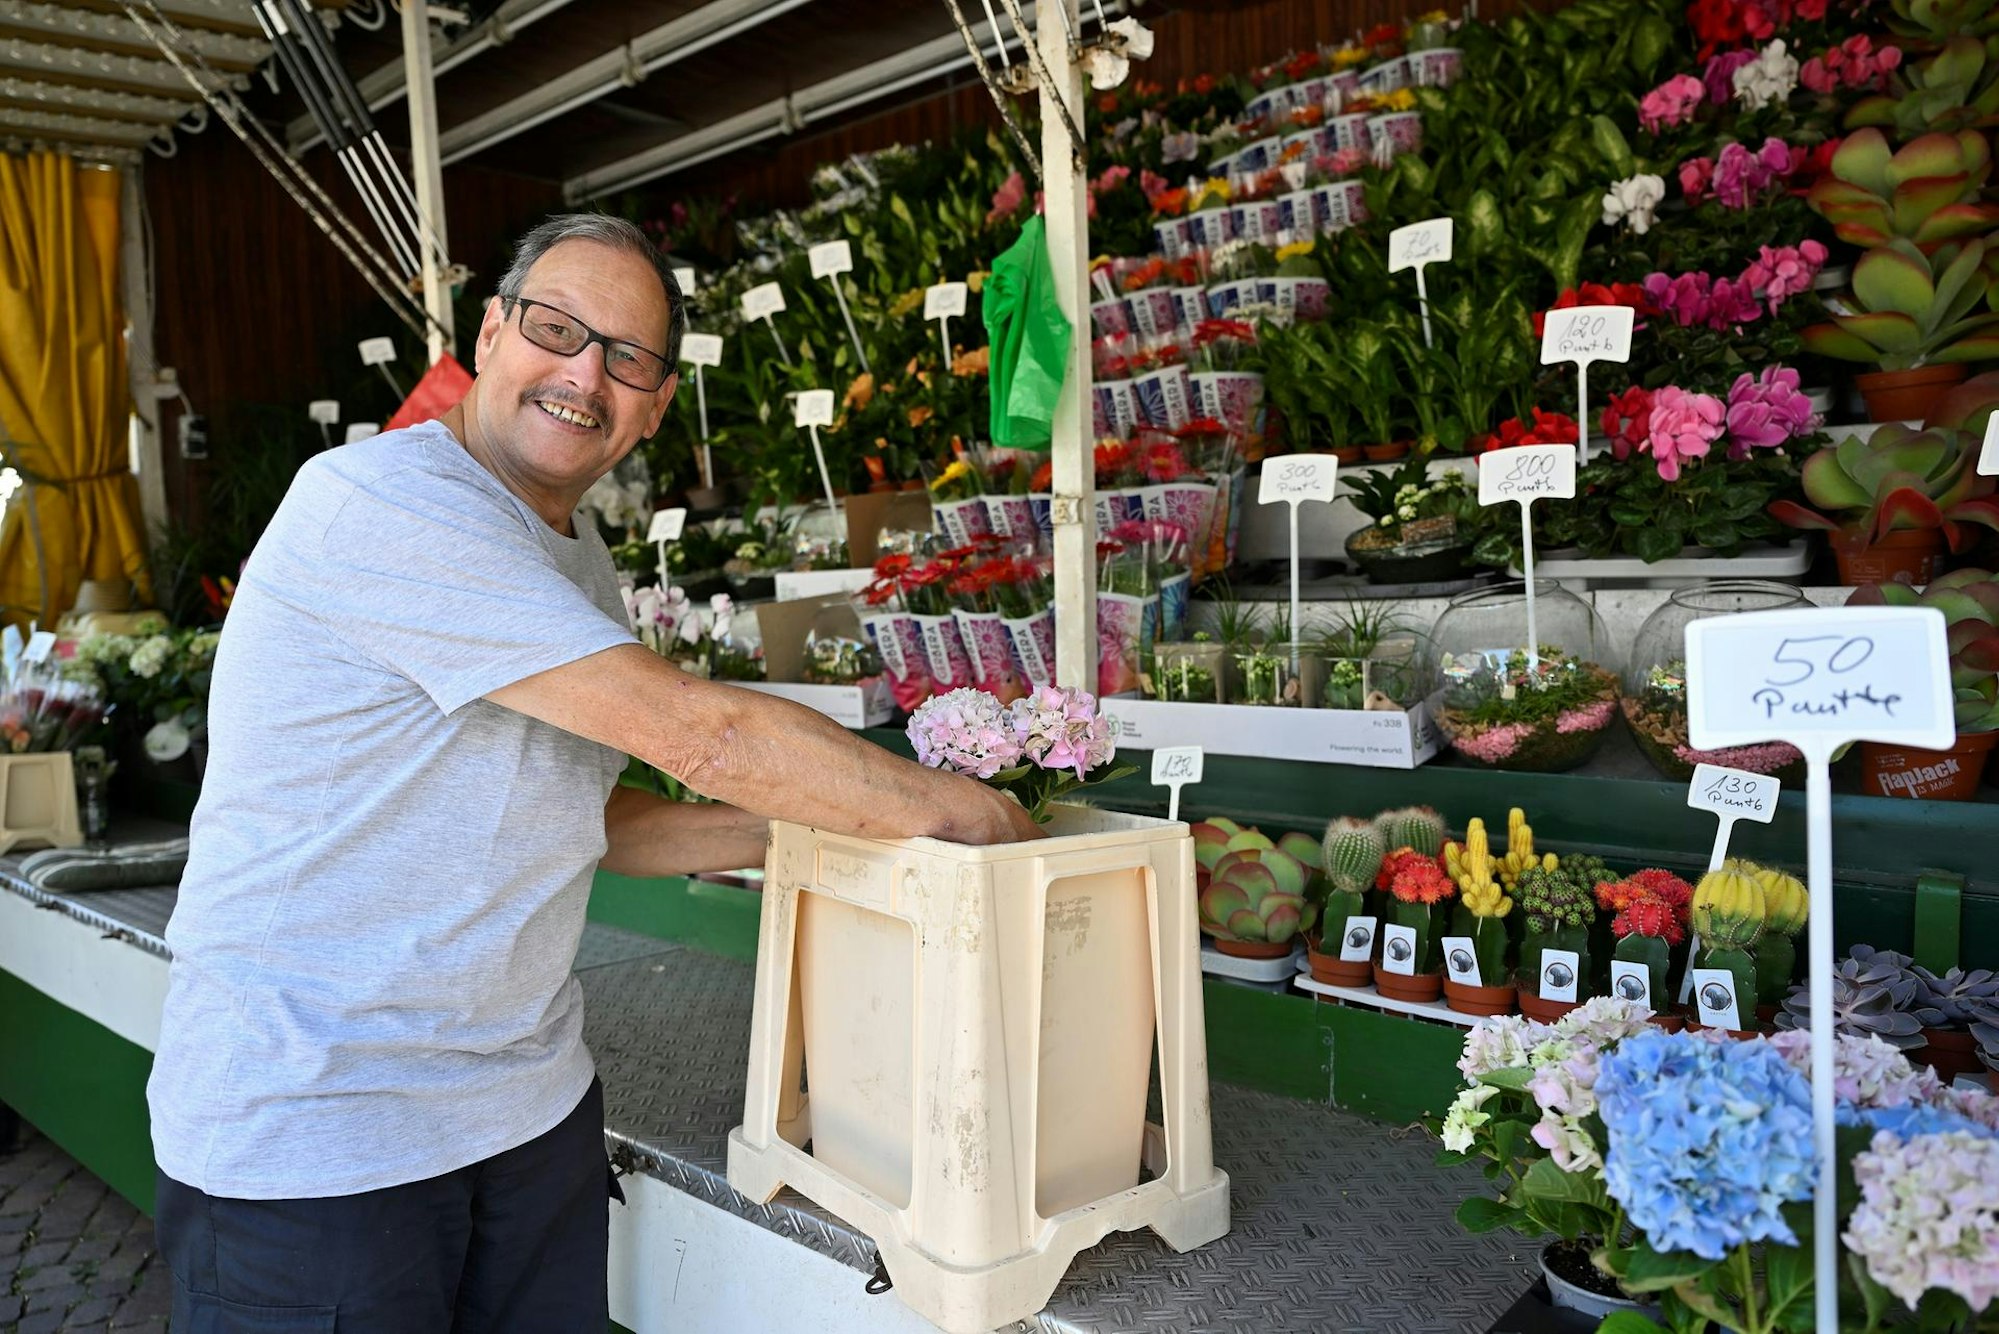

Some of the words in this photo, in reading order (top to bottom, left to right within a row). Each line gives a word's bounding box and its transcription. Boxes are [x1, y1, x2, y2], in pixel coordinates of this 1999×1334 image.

[1559, 315, 1606, 340] 120
[1279, 462, 1317, 480] 300
[1505, 453, 1556, 480] 800
[1764, 635, 1875, 687] 50
[1704, 775, 1757, 794] 130
